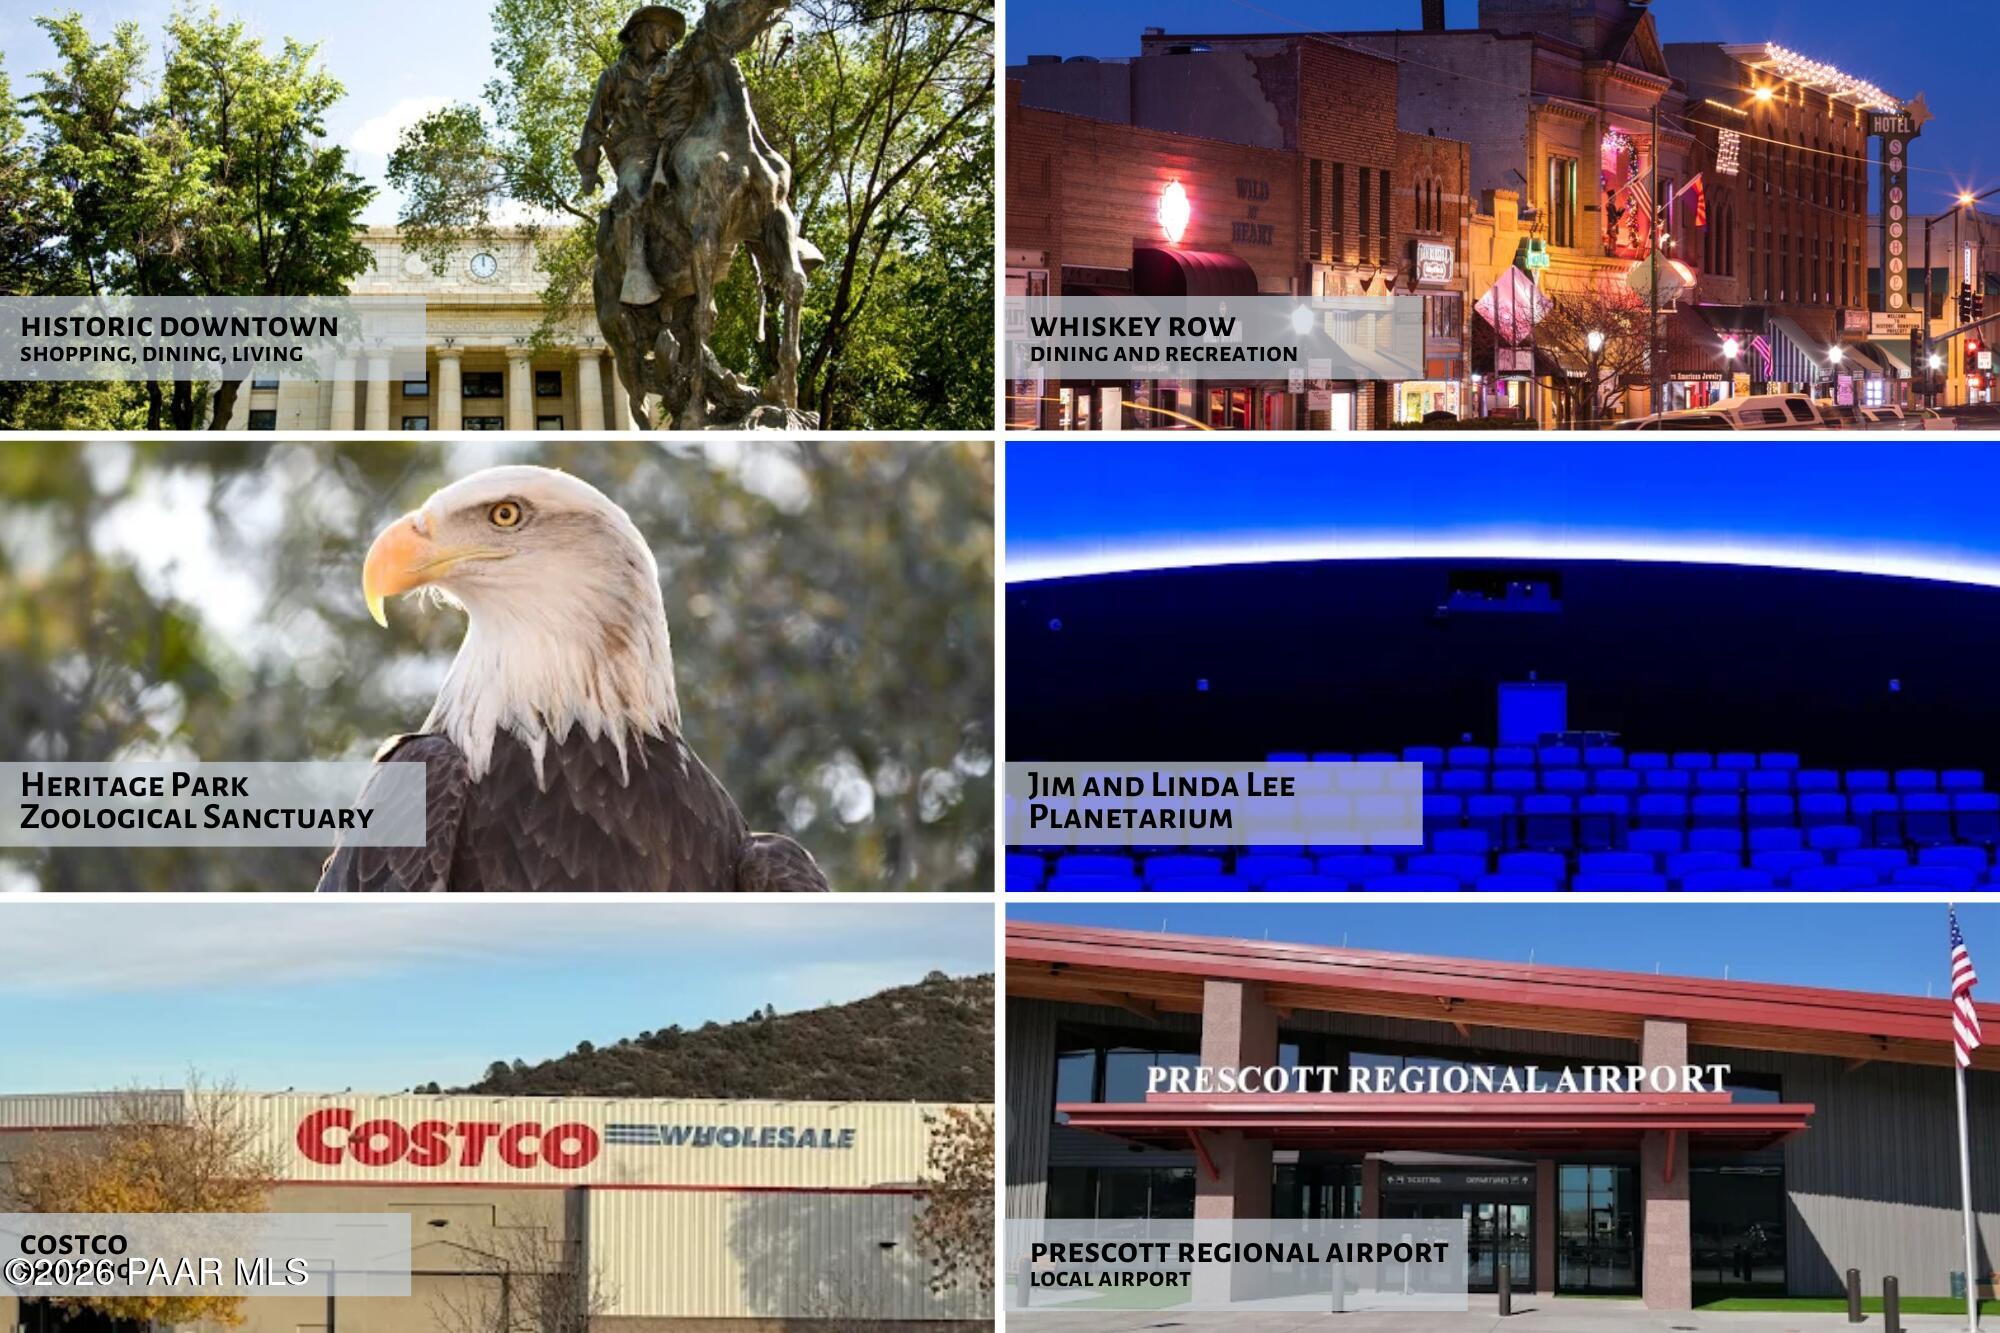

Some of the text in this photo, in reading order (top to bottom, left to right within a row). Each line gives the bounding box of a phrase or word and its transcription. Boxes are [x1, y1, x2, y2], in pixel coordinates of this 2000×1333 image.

[1874, 116, 1911, 133] HOTEL
[1236, 177, 1270, 201] WILD
[1232, 221, 1275, 246] HEART
[1889, 187, 1903, 308] MICHAEL
[1702, 372, 1722, 381] Jewelry
[1147, 1064, 1731, 1093] PRESCOTT REGIONAL AIRPORT
[297, 1108, 856, 1169] COSTCO WHOLESALE
[1407, 1176, 1509, 1184] TICKETING DEPARTURES
